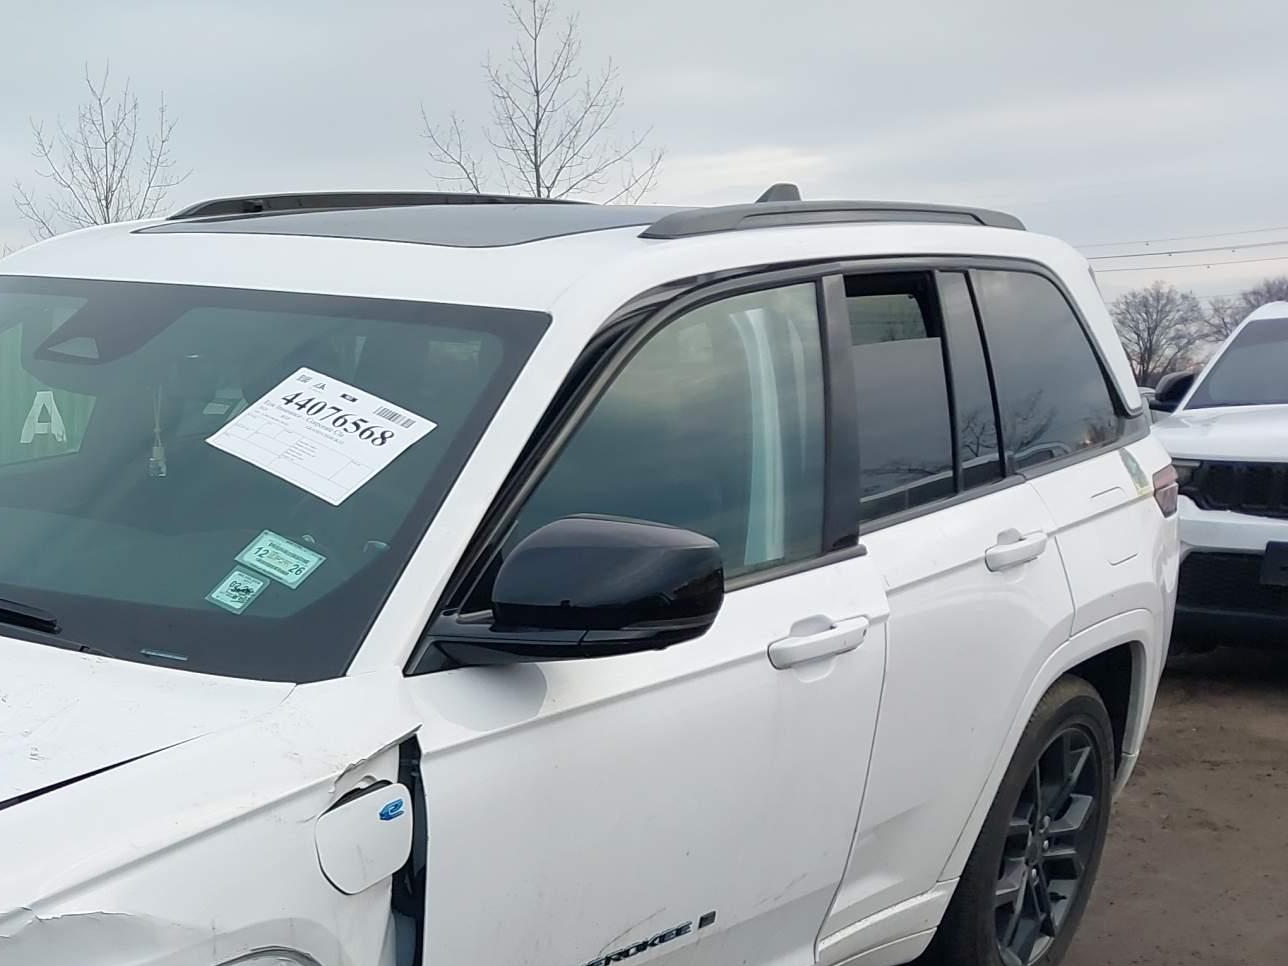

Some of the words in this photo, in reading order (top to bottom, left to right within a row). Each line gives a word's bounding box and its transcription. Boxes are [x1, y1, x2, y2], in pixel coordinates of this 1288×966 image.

[282, 391, 396, 447] 44076568
[253, 546, 270, 558] 12
[288, 564, 306, 576] 26
